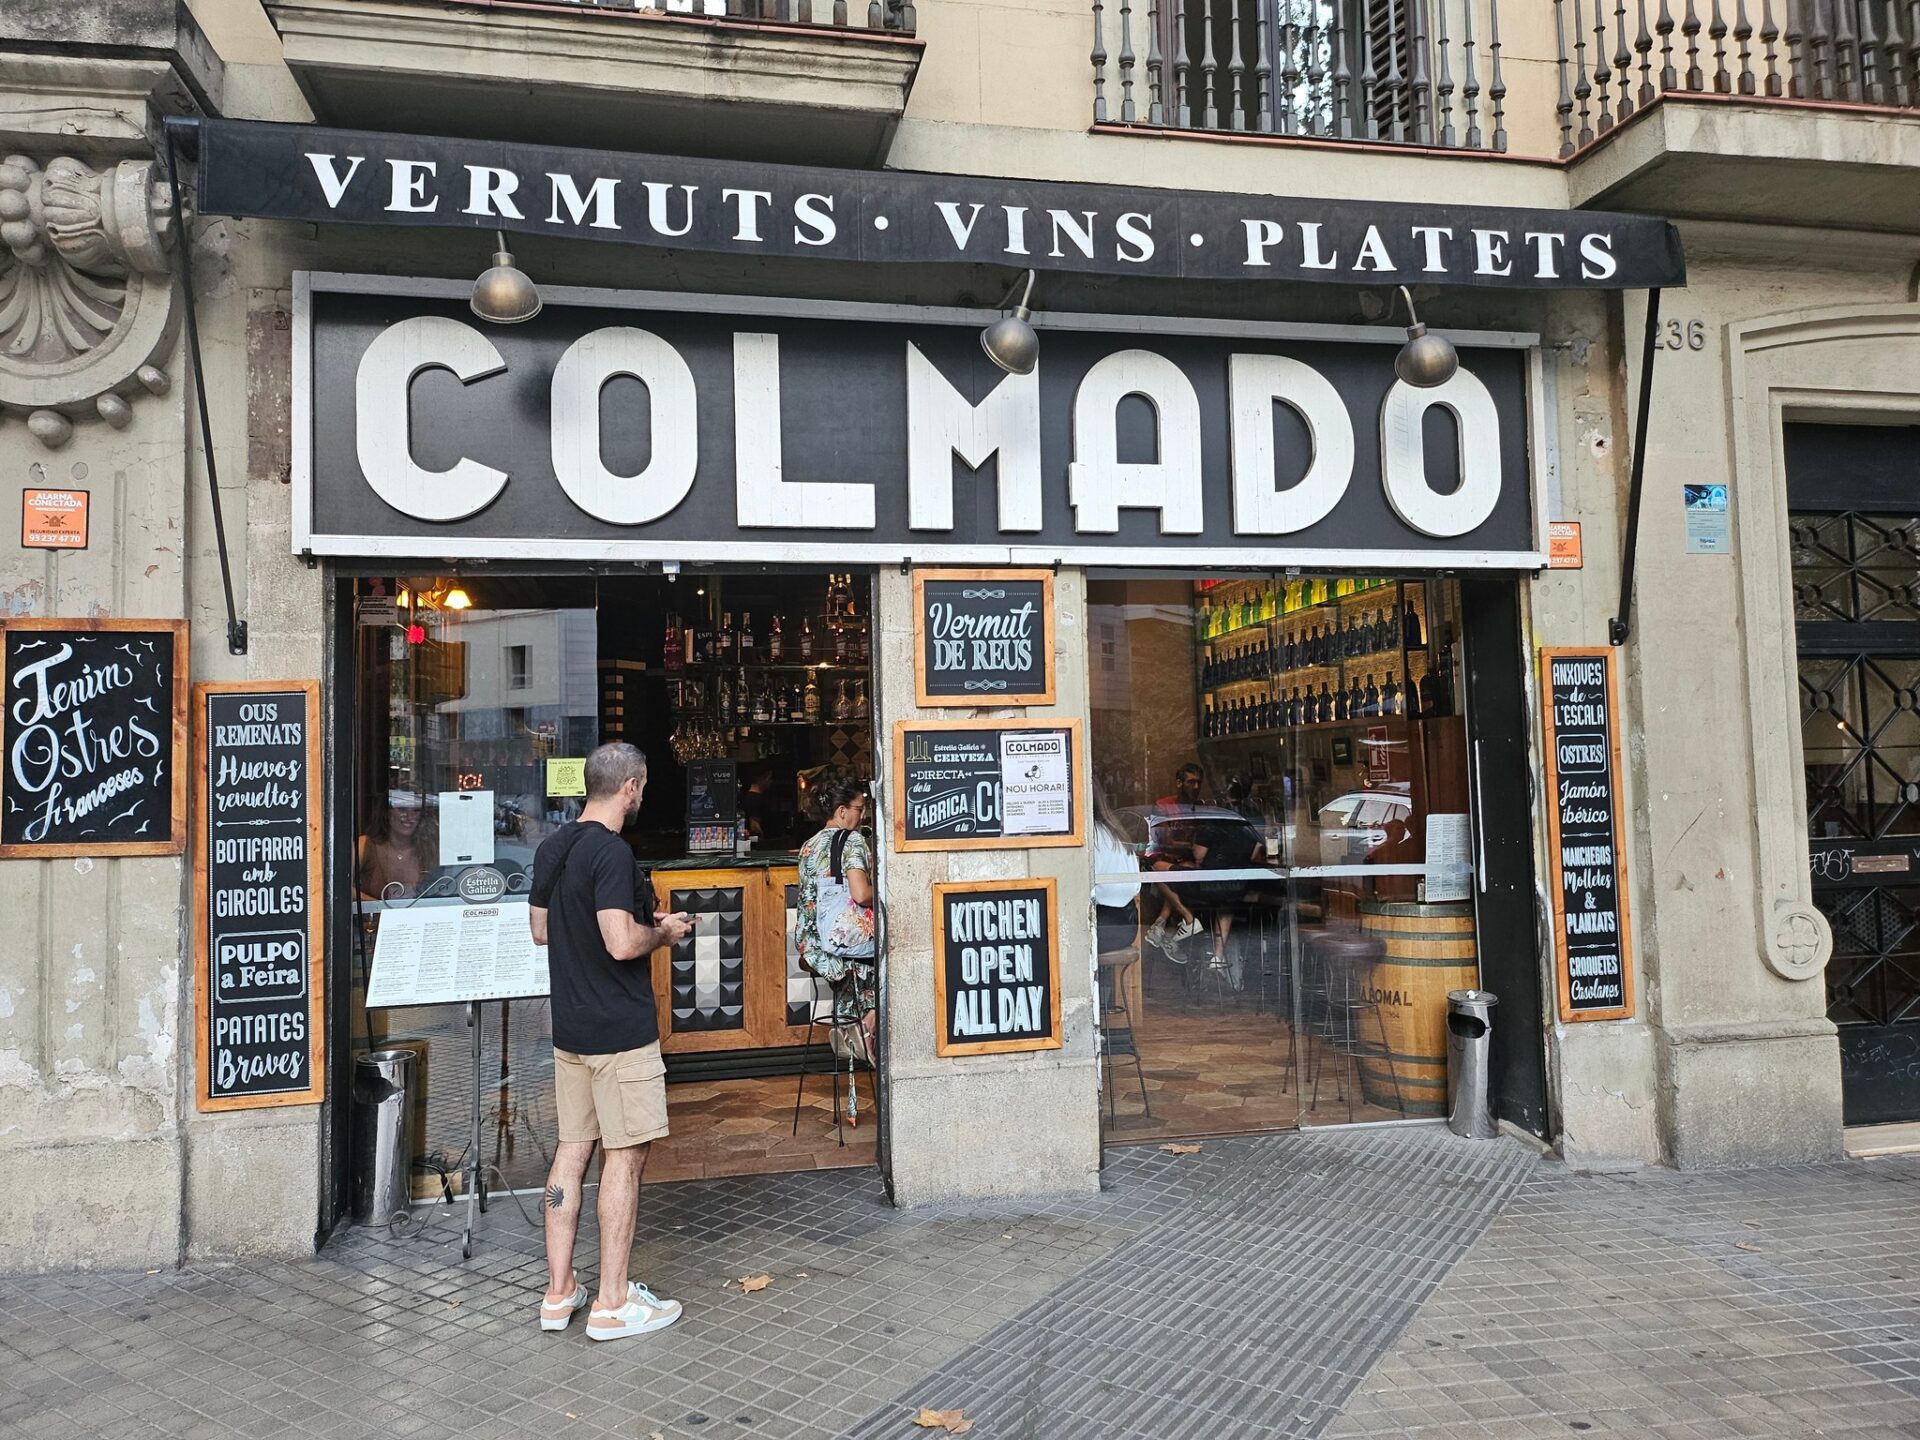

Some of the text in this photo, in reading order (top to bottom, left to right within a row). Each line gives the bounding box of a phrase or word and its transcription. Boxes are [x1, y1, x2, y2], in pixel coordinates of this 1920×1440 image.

[303, 152, 1619, 281] VERMUTS VINS PLATETS
[355, 314, 1502, 539] COLMADO
[28, 499, 82, 507] CONECTADA
[29, 534, 40, 542] 93
[69, 535, 81, 543] 70
[929, 601, 1039, 639] Vermut
[933, 638, 1033, 672] DE REUS
[12, 642, 133, 726] Tenim
[1552, 663, 1603, 687] ANXOVES
[1569, 686, 1587, 703] de
[239, 703, 278, 723] OUS
[1554, 704, 1605, 727] L'ESCALA
[215, 723, 302, 747] REMENATS
[11, 710, 160, 792] Ostres
[933, 743, 980, 752] Estrella Galicia
[933, 753, 995, 763] CERVEZA
[1008, 742, 1058, 753] COLMADO
[1560, 744, 1604, 764] OSTRES
[215, 754, 302, 788] Huevos
[916, 769, 967, 780] DIRECTA
[215, 782, 302, 813] revueltos
[1006, 783, 1065, 793] NOU HORARI
[1559, 779, 1609, 807] Jamón
[914, 793, 969, 829] FÁBRICA
[1562, 804, 1609, 825] ibérico
[216, 836, 304, 865] BOTIFARRA
[1562, 845, 1613, 868] MANCHEGOS
[242, 861, 277, 883] amb
[466, 877, 499, 886] Estrella
[1564, 868, 1613, 894] Molletes
[216, 885, 304, 918] GIRGOLES
[467, 885, 497, 894] Galicia
[1584, 891, 1597, 910] &
[951, 898, 1041, 943] KITCHEN
[1566, 911, 1616, 935] PLANXATS
[221, 941, 300, 965] PULPO
[961, 944, 1034, 985] OPEN
[221, 963, 300, 989] a Feira
[1569, 954, 1619, 978] CROQUETES
[1570, 977, 1620, 1001] Casolanes
[953, 986, 1044, 1037] ALL DAY
[216, 1012, 305, 1046] PATATES
[217, 1049, 305, 1090] Braves
